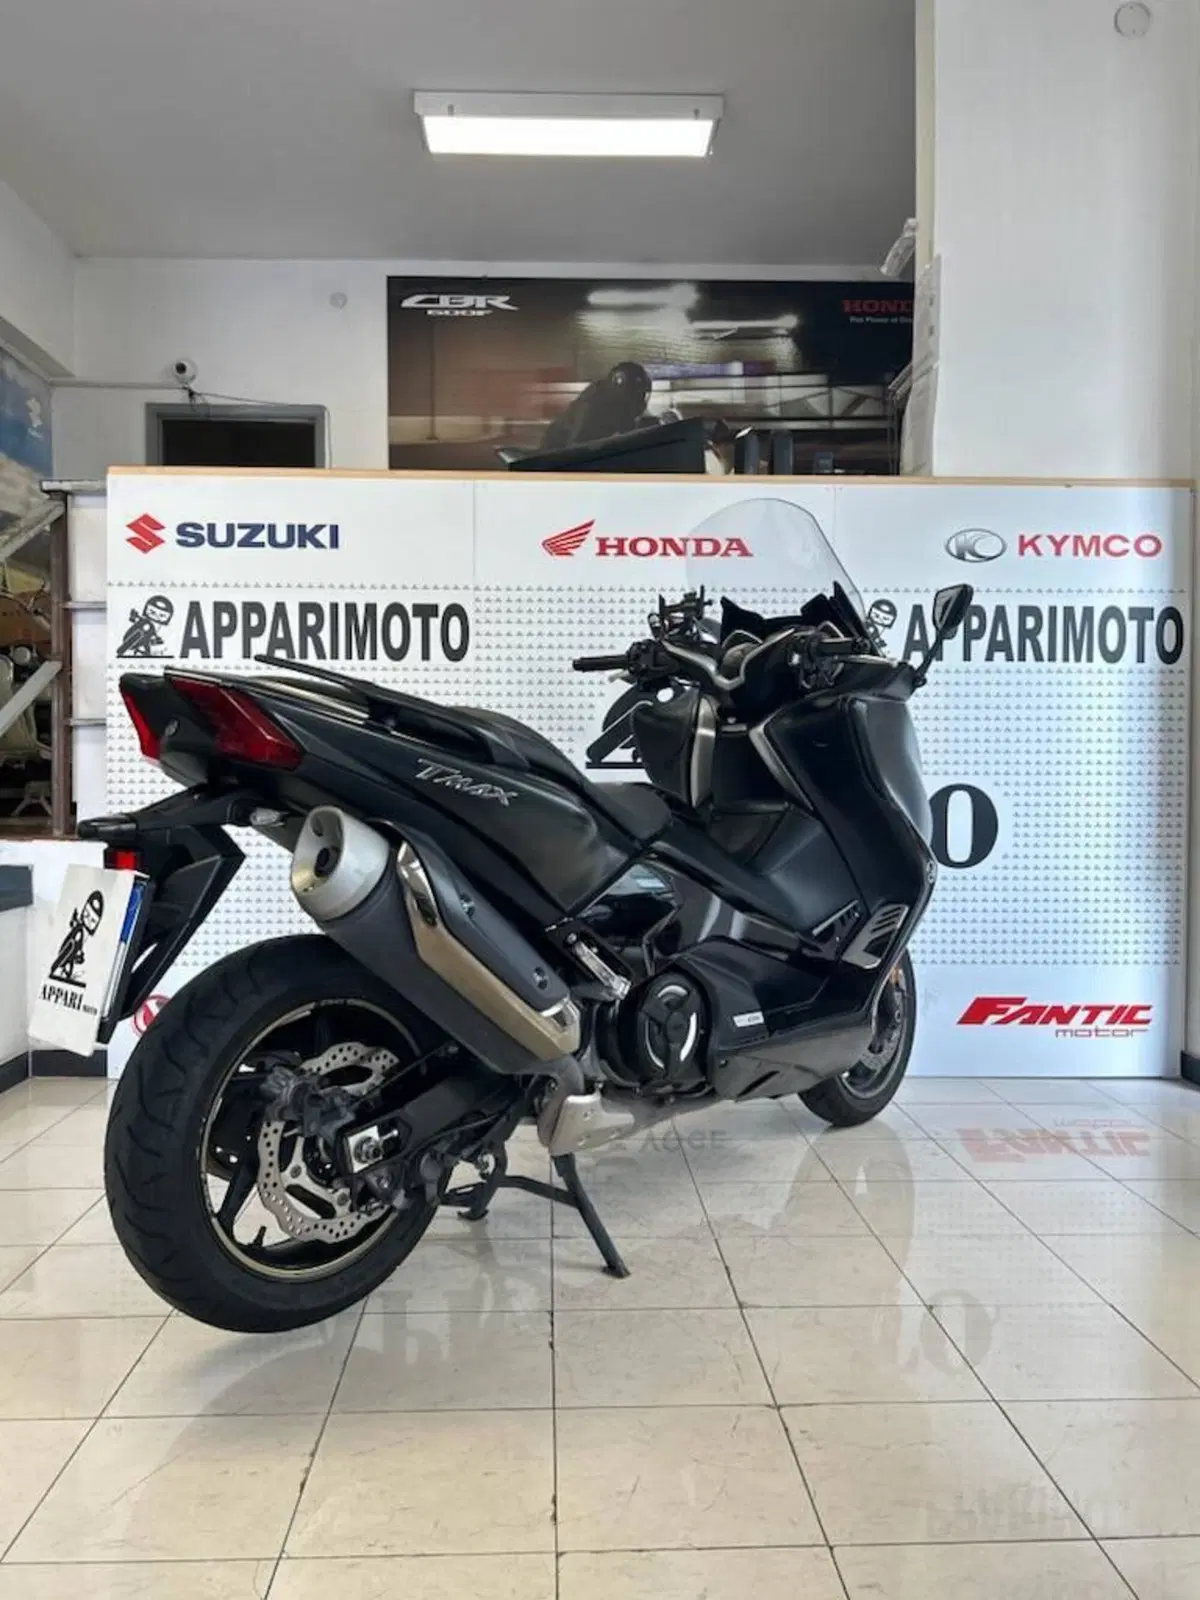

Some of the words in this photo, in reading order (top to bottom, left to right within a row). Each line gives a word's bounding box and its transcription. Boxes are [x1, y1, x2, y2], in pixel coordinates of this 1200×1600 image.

[401, 294, 519, 310] CBR
[175, 522, 340, 549] SUZUKI
[595, 537, 754, 557] HONDA
[1018, 534, 1162, 557] KYMCO
[179, 600, 471, 662] APPARIMOTO
[956, 997, 1153, 1025] FANTIC
[1055, 1028, 1150, 1038] motor
